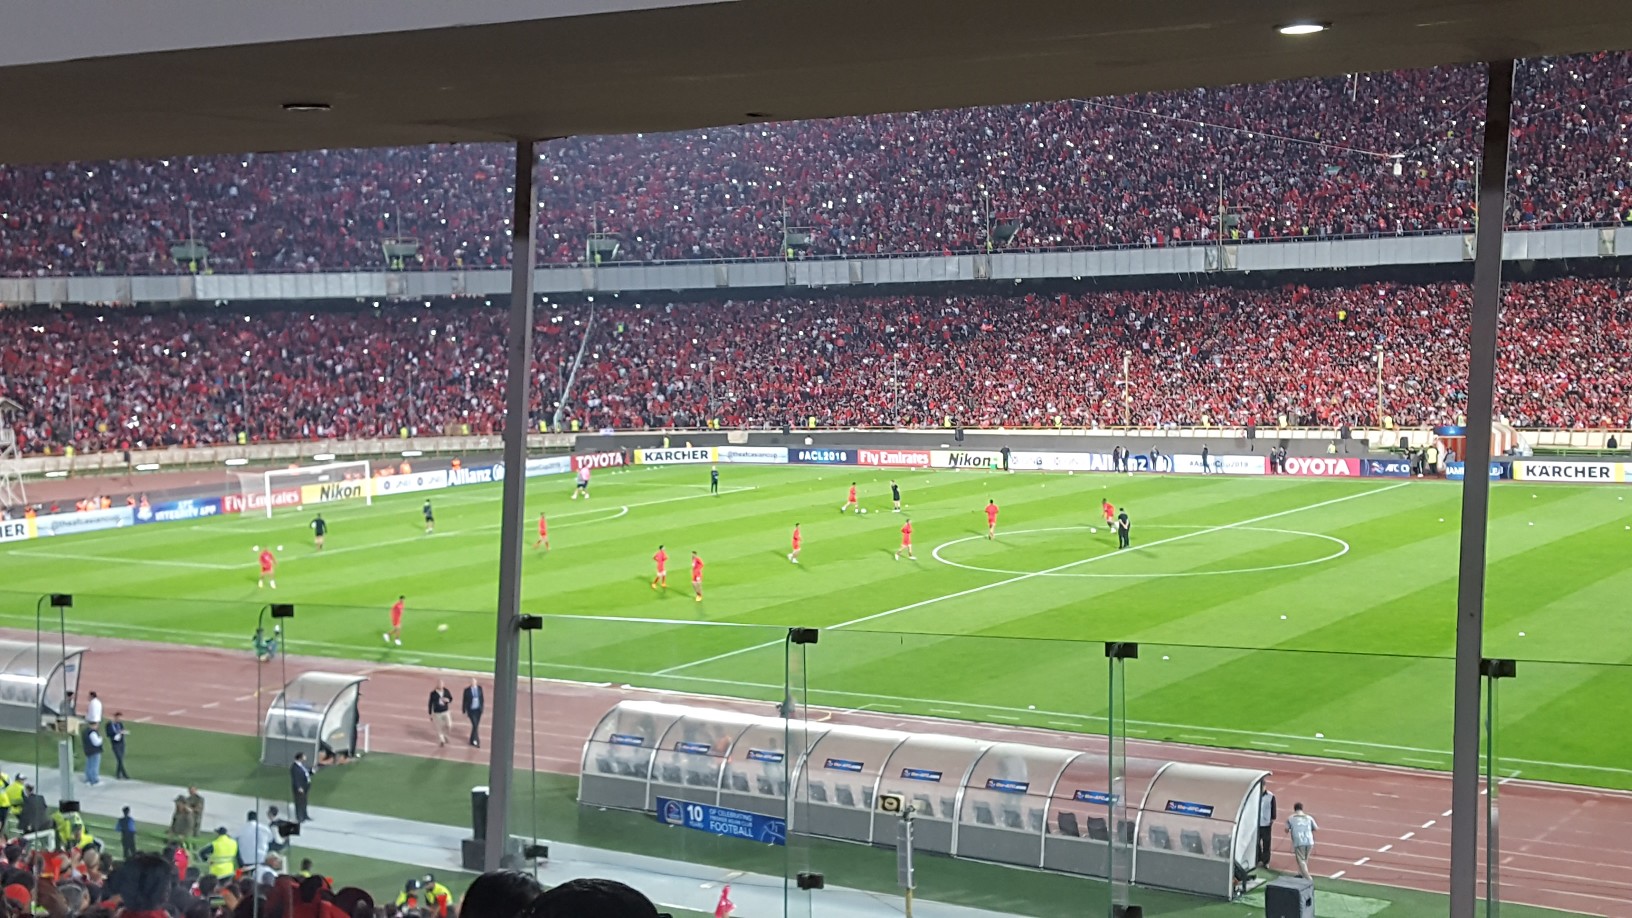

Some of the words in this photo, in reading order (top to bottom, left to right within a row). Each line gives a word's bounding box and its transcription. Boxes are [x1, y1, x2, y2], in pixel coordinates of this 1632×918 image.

[576, 452, 623, 469] TOYOTA
[860, 451, 878, 465] Fly
[880, 452, 929, 465] Emirates
[948, 453, 991, 467] Nikon
[448, 468, 491, 485] Allianz
[320, 484, 361, 500] Nikon
[225, 495, 247, 511] Fly
[687, 804, 703, 821] 10
[709, 821, 753, 837] FOOTBALL
